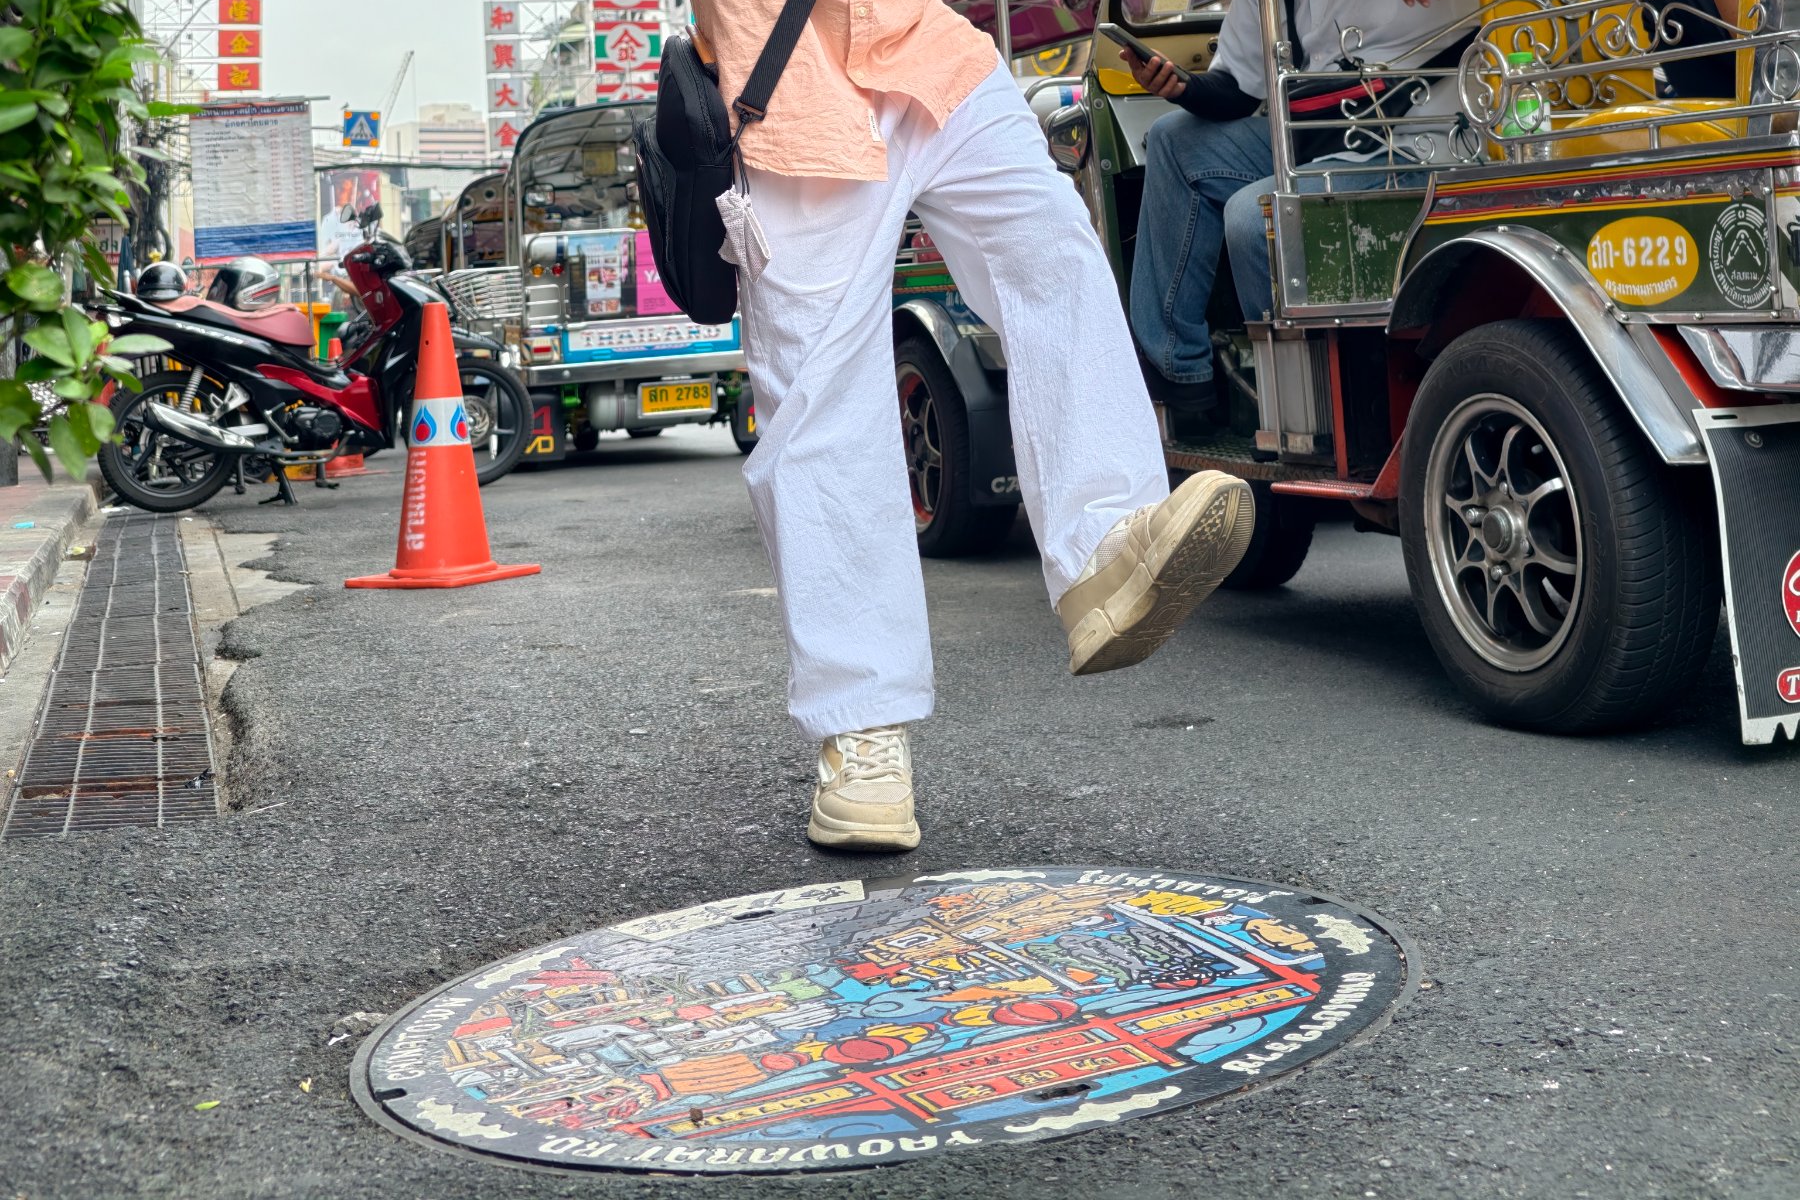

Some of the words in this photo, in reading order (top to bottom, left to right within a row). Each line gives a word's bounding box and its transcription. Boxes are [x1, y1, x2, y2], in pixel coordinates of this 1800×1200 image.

[1605, 276, 1678, 300] กรุงเทพมหานคร
[580, 324, 721, 347] THAILAND
[676, 385, 709, 401] 2783
[541, 1134, 618, 1157] RD.
[625, 1130, 984, 1166] YAOWARAT
